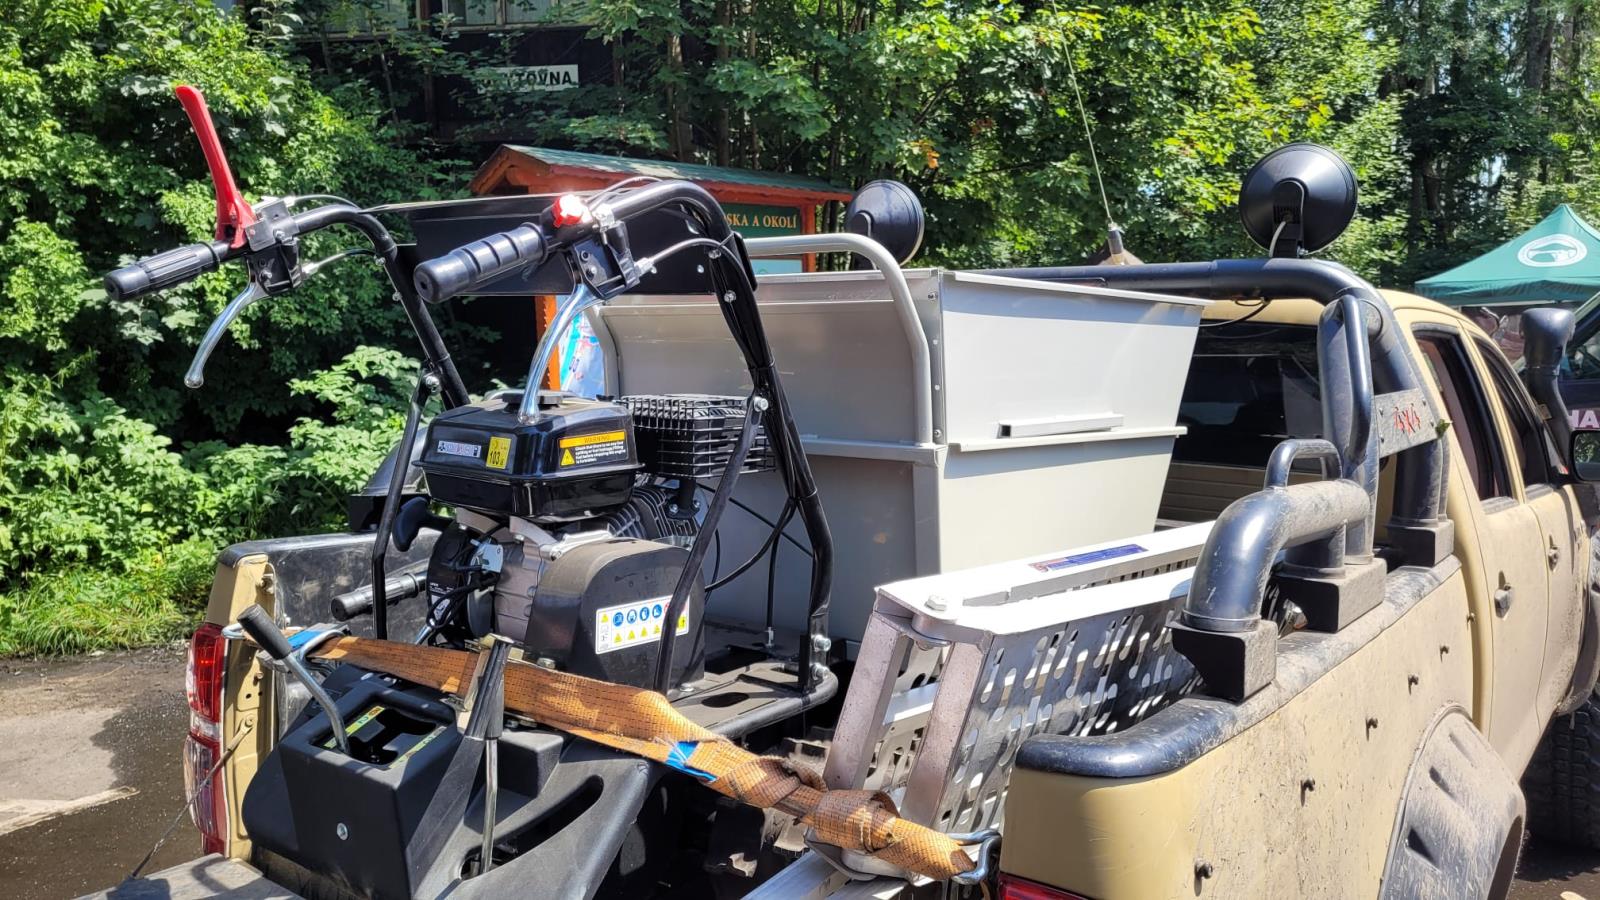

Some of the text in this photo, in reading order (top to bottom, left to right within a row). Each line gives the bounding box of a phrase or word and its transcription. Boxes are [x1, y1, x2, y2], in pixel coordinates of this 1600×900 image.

[752, 215, 760, 226] A
[763, 215, 797, 228] OKOLÍ
[490, 451, 500, 465] 103
